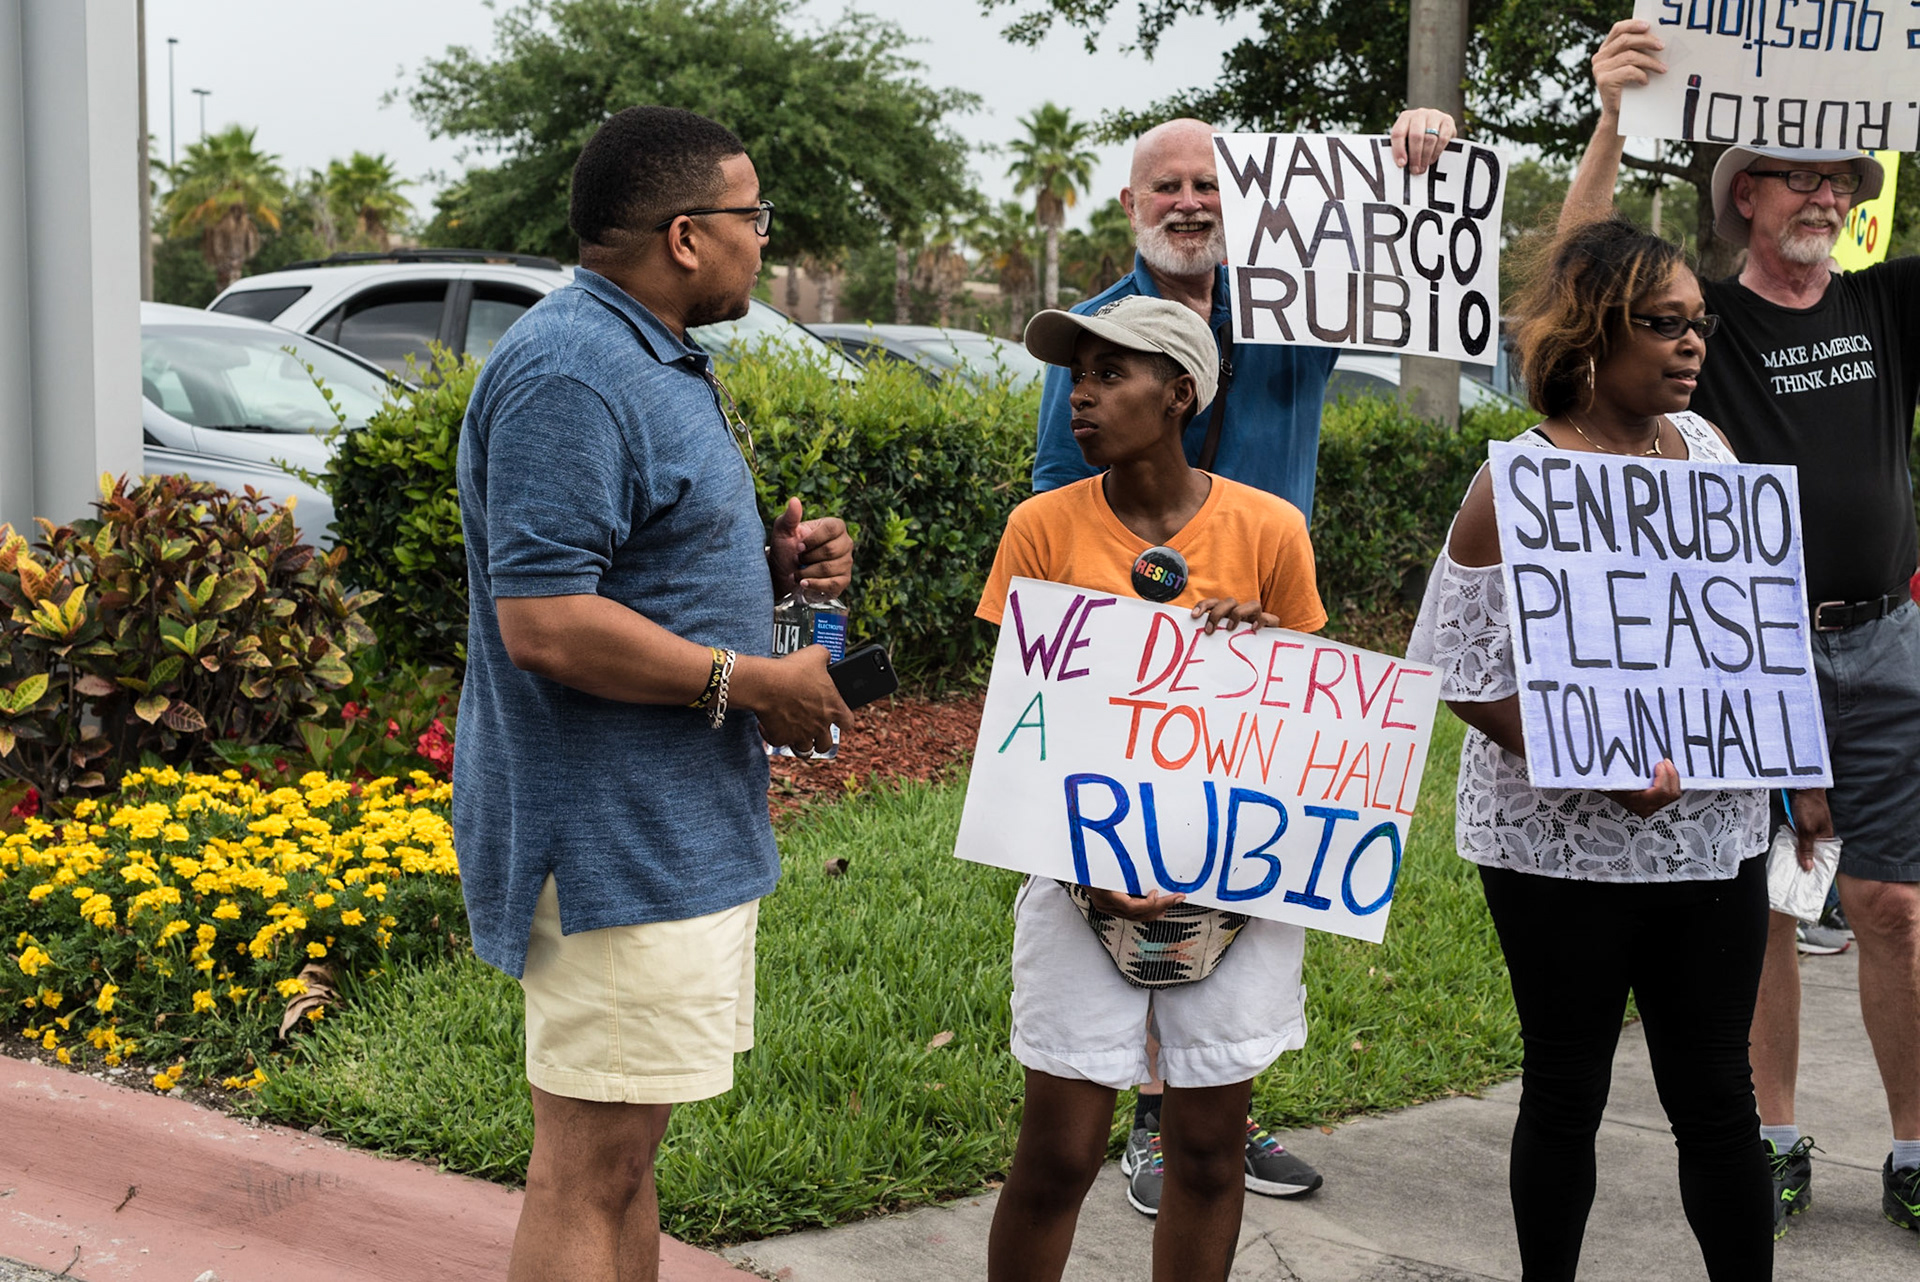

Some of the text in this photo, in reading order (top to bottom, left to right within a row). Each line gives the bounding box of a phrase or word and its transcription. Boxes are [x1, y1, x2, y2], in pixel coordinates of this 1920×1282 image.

[1213, 136, 1501, 220] WANTED
[1247, 199, 1482, 286] MARCO
[1845, 206, 1878, 254] RCO
[1761, 334, 1873, 368] MAKE AMERICA
[1771, 361, 1877, 394] THINK AGAIN
[1623, 464, 1792, 566] RUBIO
[1135, 559, 1184, 590] RESIST
[1513, 564, 1806, 675] PLEASE
[1009, 590, 1433, 731] WE DESERVE
[998, 691, 1417, 816] A TOWN HALL
[1527, 681, 1823, 779] TOWN HALL
[1064, 772, 1402, 917] RUBIO
